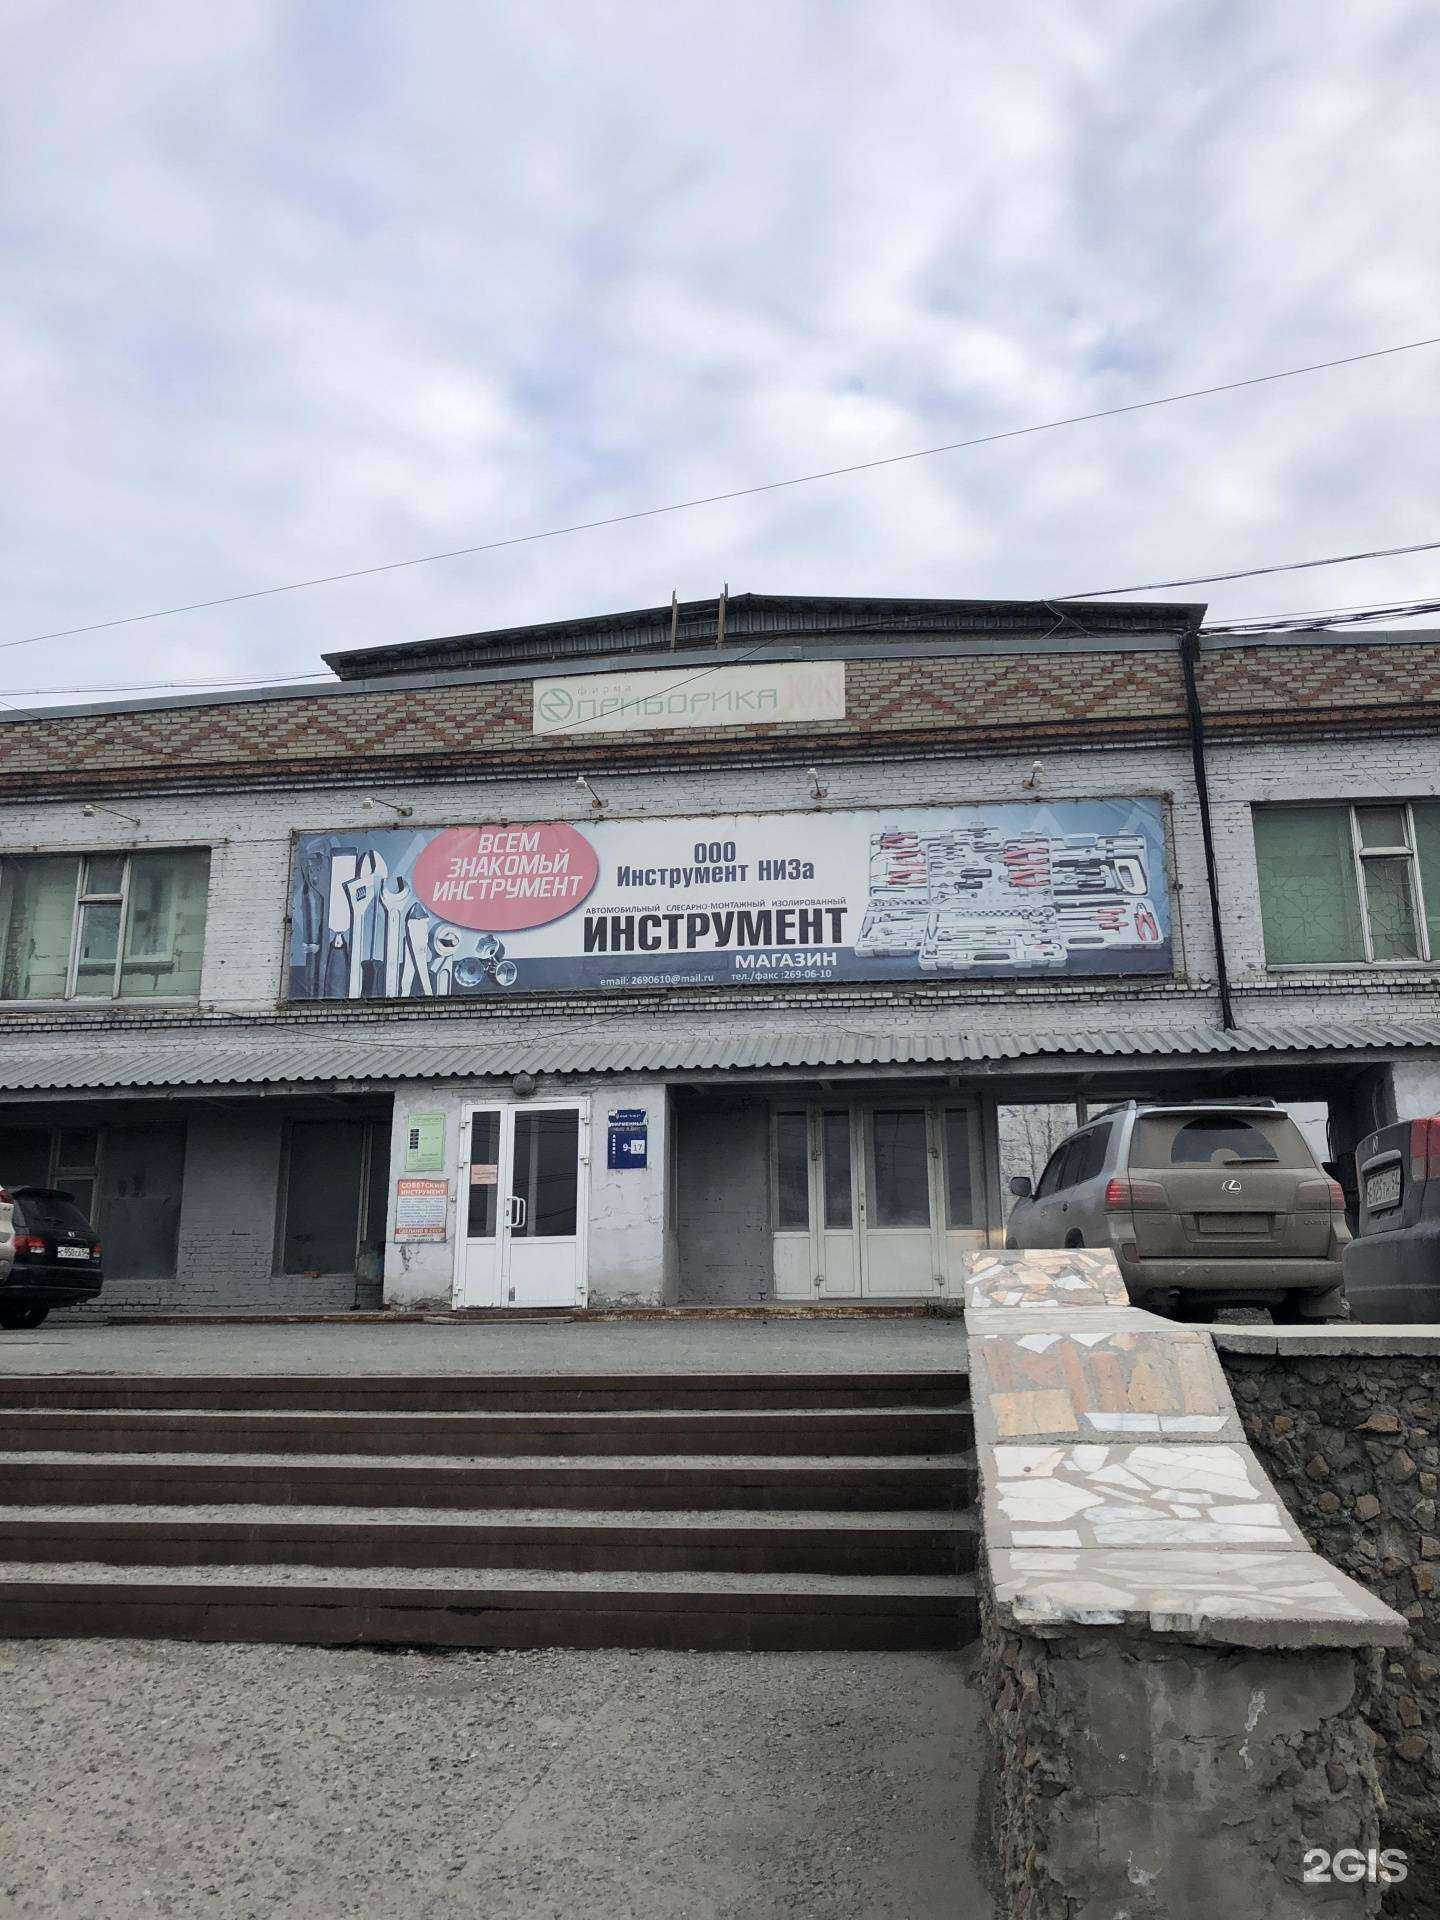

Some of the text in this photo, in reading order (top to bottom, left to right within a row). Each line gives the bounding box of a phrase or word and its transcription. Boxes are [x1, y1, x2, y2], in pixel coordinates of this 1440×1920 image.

[577, 688, 778, 718] ПРИБОРИКА
[477, 831, 541, 854] ВСЕМ
[694, 841, 736, 863] ООО
[617, 858, 814, 888] Инструмент НИЗа
[432, 875, 584, 902] ИНСТРУМЕНТ
[586, 897, 847, 915] АВТОМОБИЛЬНЫЙ СЛЕСАРНО-МОНТАЖНЫЙ ИЗОЛИРОВАННЫЙ
[584, 907, 848, 953] ИНСТРУМЕНТ
[735, 952, 837, 969] МАГАЗИН
[600, 974, 714, 987] email: 2690610@mail.ru
